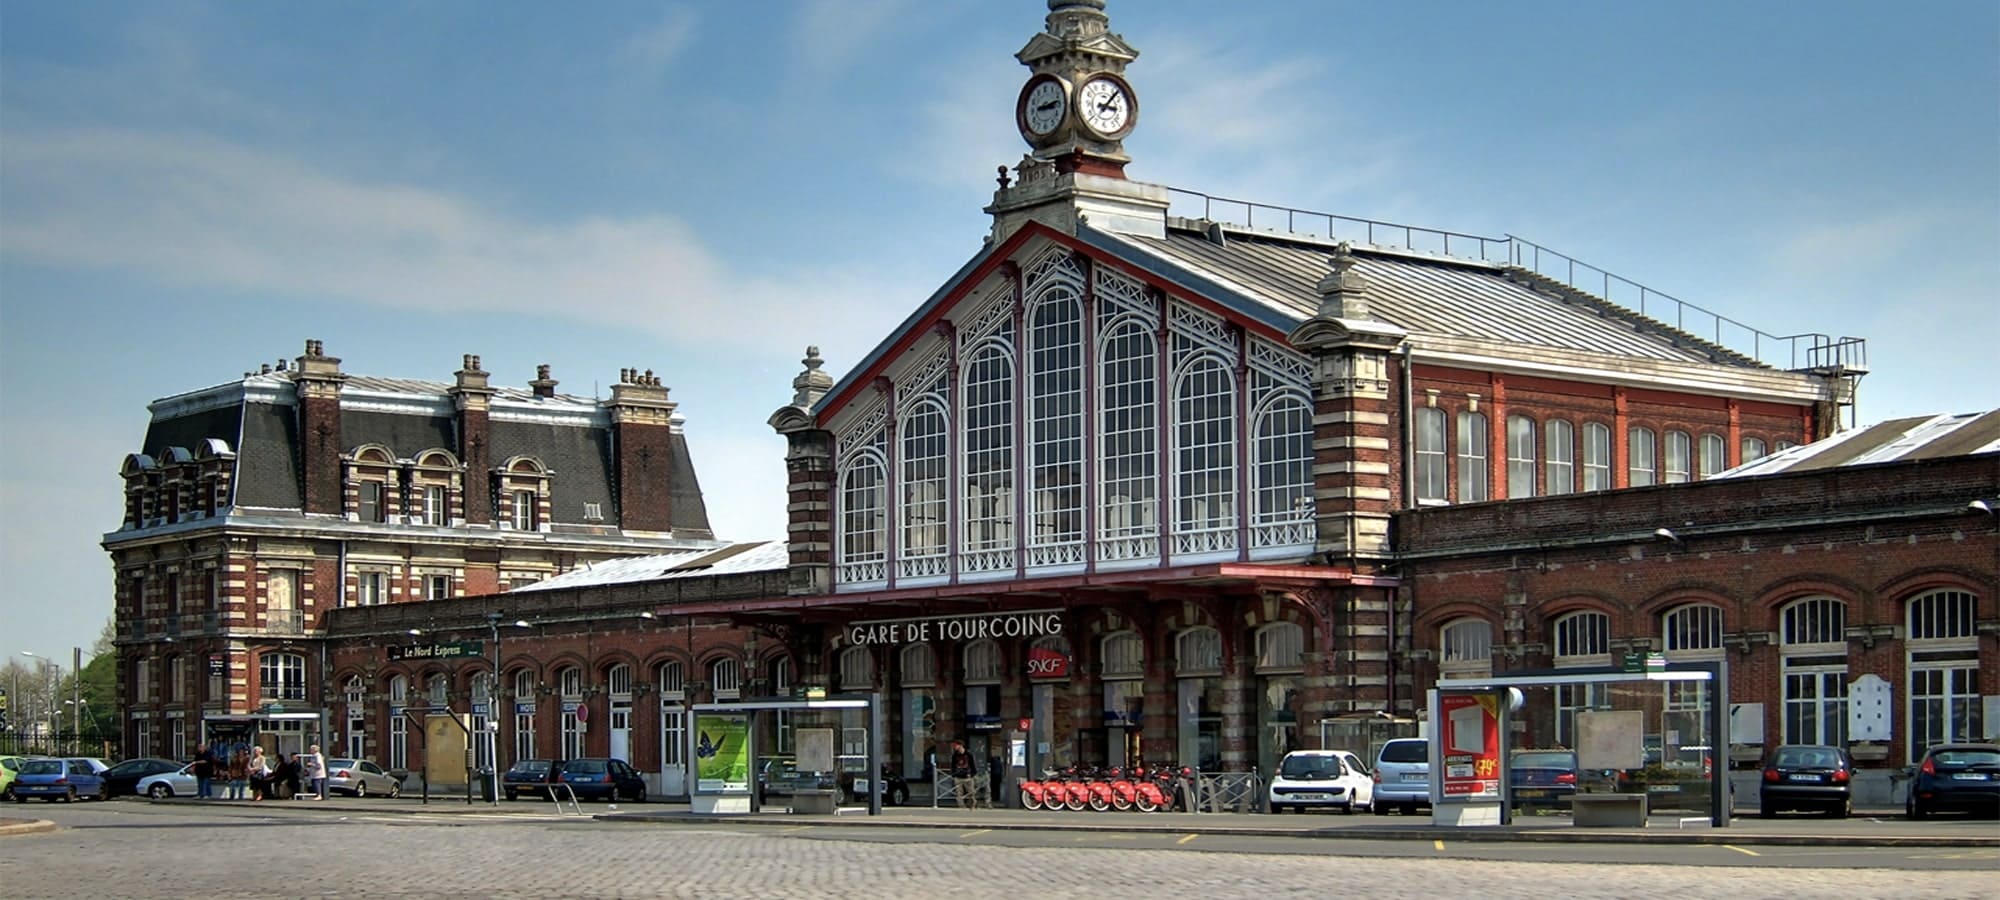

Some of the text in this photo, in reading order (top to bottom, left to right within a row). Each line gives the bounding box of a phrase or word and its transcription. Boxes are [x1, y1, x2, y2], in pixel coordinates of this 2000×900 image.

[851, 614, 1062, 646] GARE DE TOURCOING
[414, 645, 433, 657] Nord
[1027, 658, 1063, 674] SNCF
